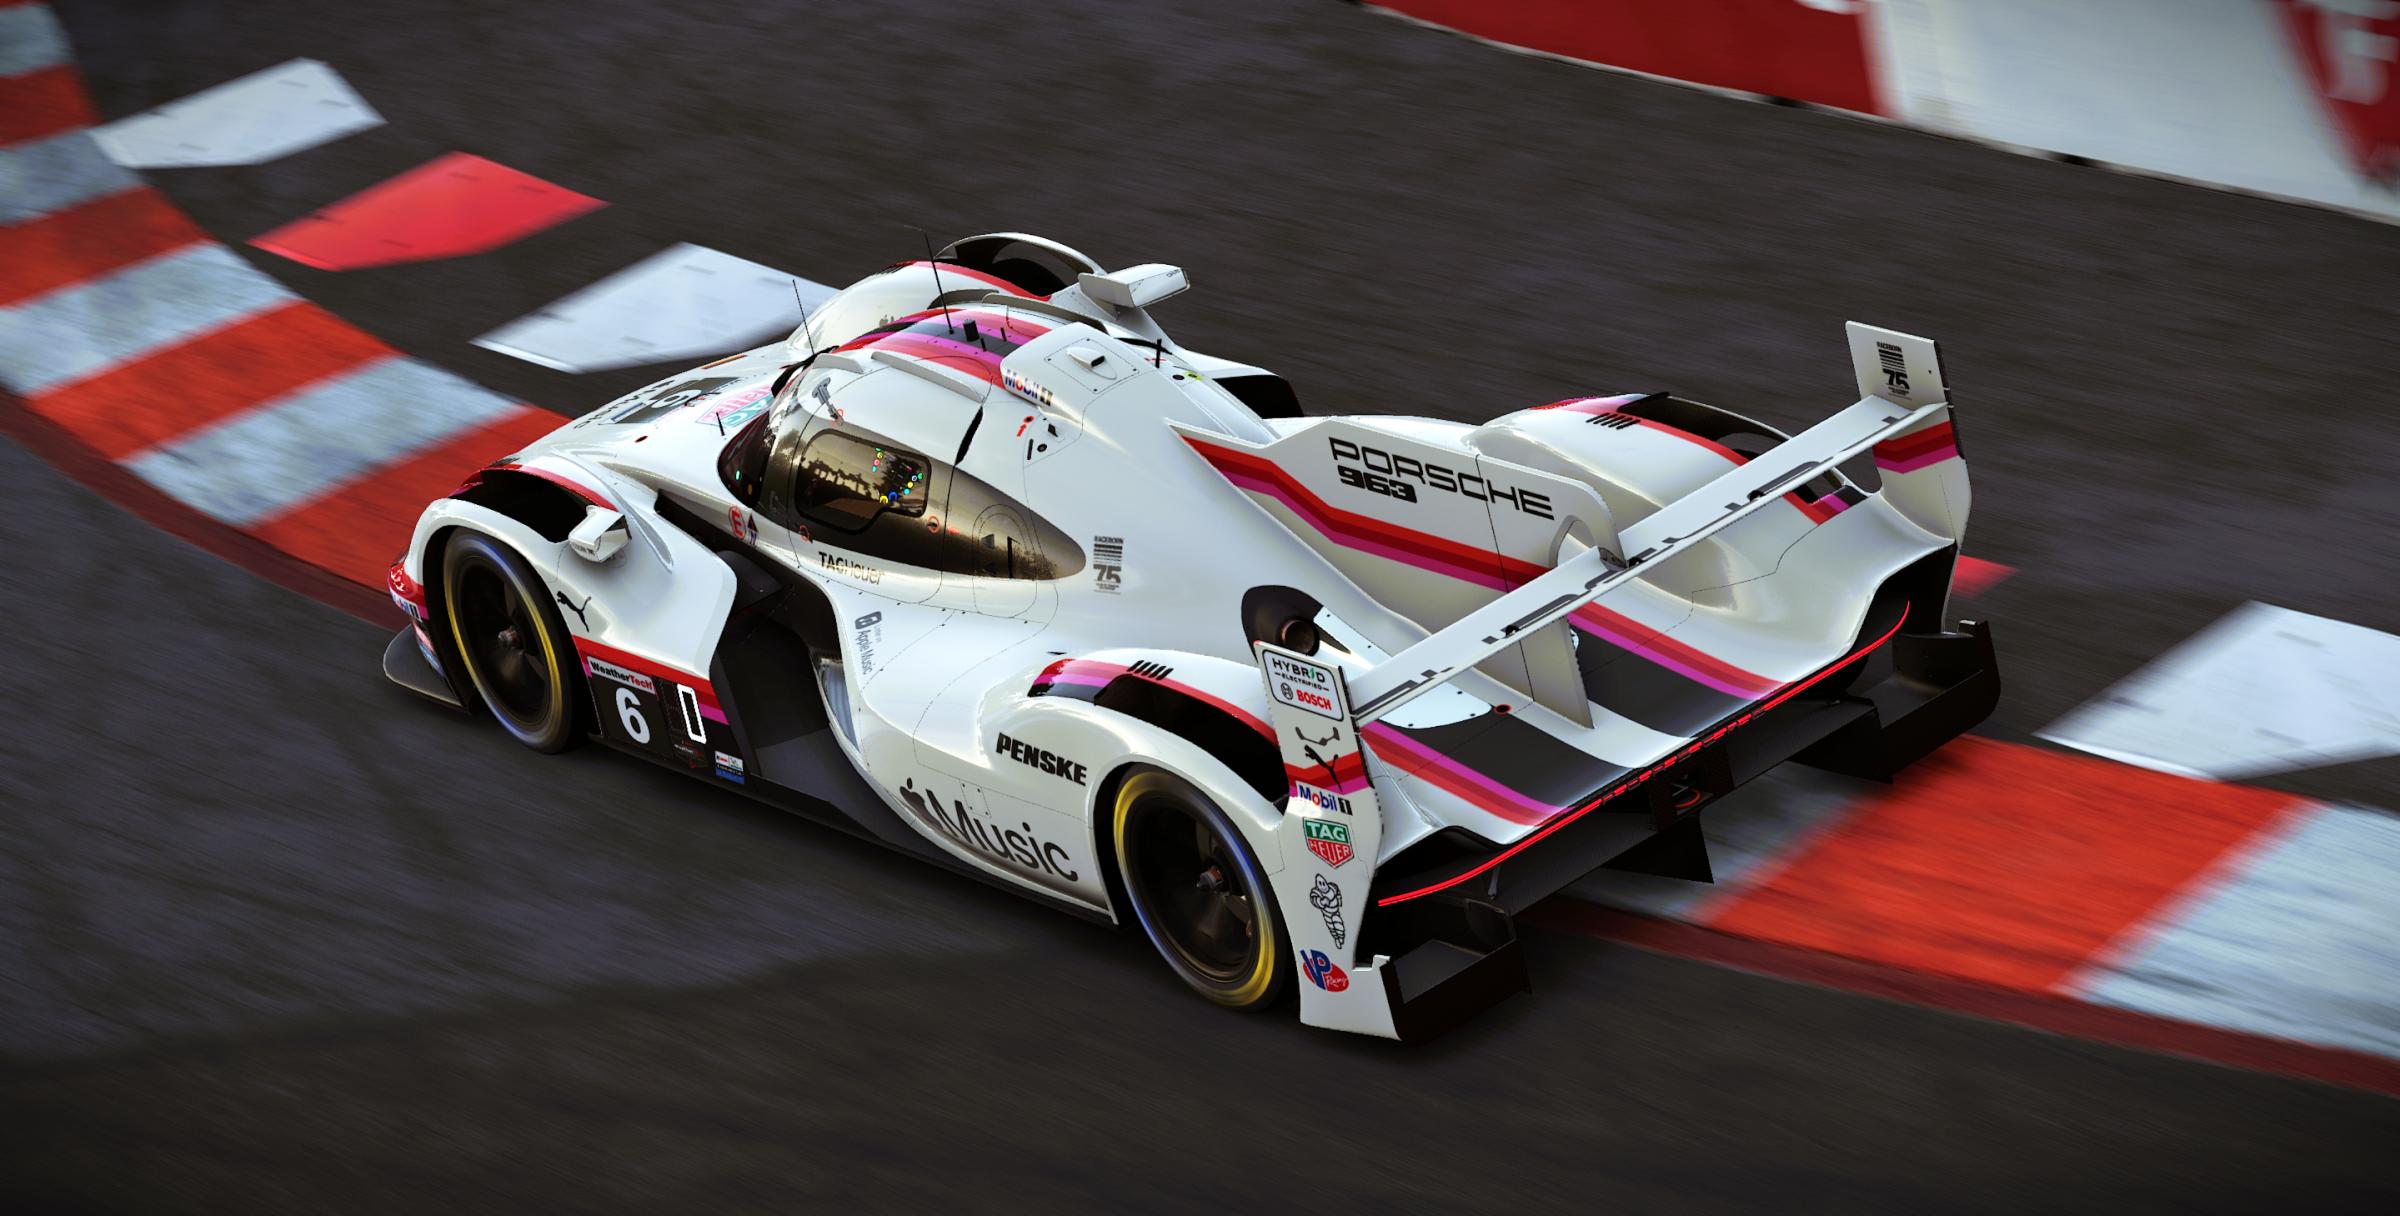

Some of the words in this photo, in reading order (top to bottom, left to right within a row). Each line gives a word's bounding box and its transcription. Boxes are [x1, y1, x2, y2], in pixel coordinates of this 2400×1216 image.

[1005, 368, 1039, 400] Mobil
[1882, 368, 1910, 390] 75
[1329, 437, 1555, 521] PORSCHE
[1337, 465, 1418, 504] 963
[1093, 564, 1121, 584] 75
[615, 687, 651, 744] 6
[1296, 689, 1332, 711] BOSCH
[995, 732, 1087, 786] PENSKE
[1299, 785, 1337, 812] Mobil
[1338, 797, 1353, 816] 1
[925, 789, 1079, 882] Music
[1307, 821, 1347, 843] TAG
[1308, 839, 1353, 867] HEUER
[1300, 949, 1332, 990] VP
